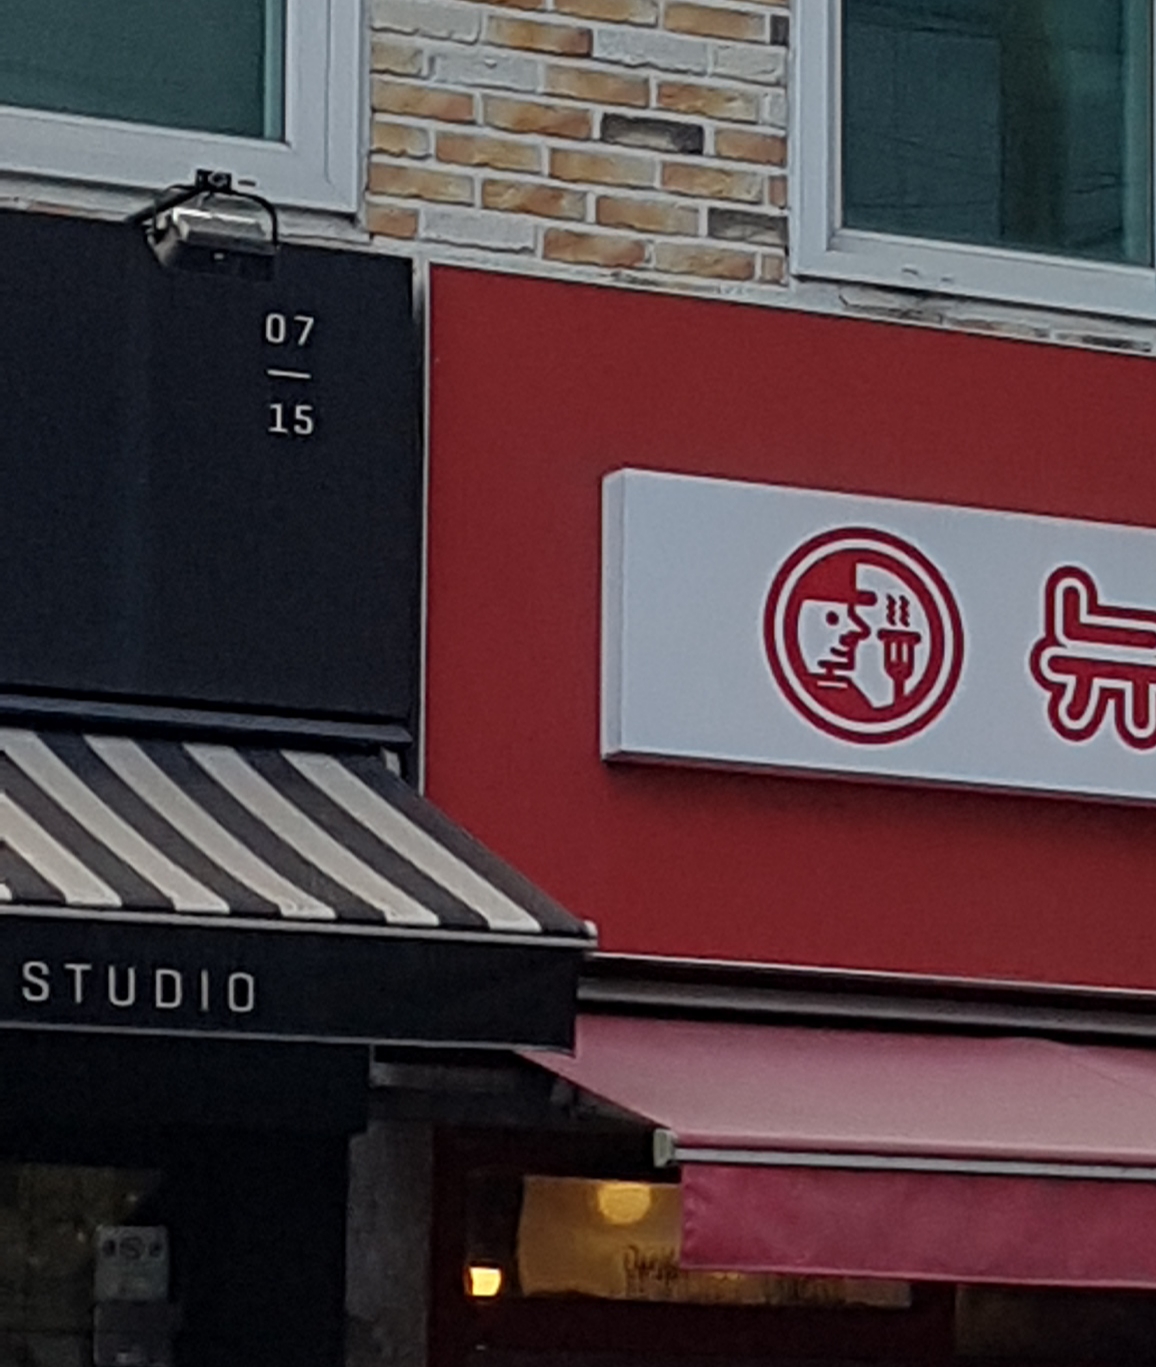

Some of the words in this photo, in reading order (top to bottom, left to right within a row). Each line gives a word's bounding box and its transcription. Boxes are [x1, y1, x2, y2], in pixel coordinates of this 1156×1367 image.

[263, 311, 316, 346] 07
[267, 402, 316, 437] 15
[21, 960, 258, 1014] STUDIO
